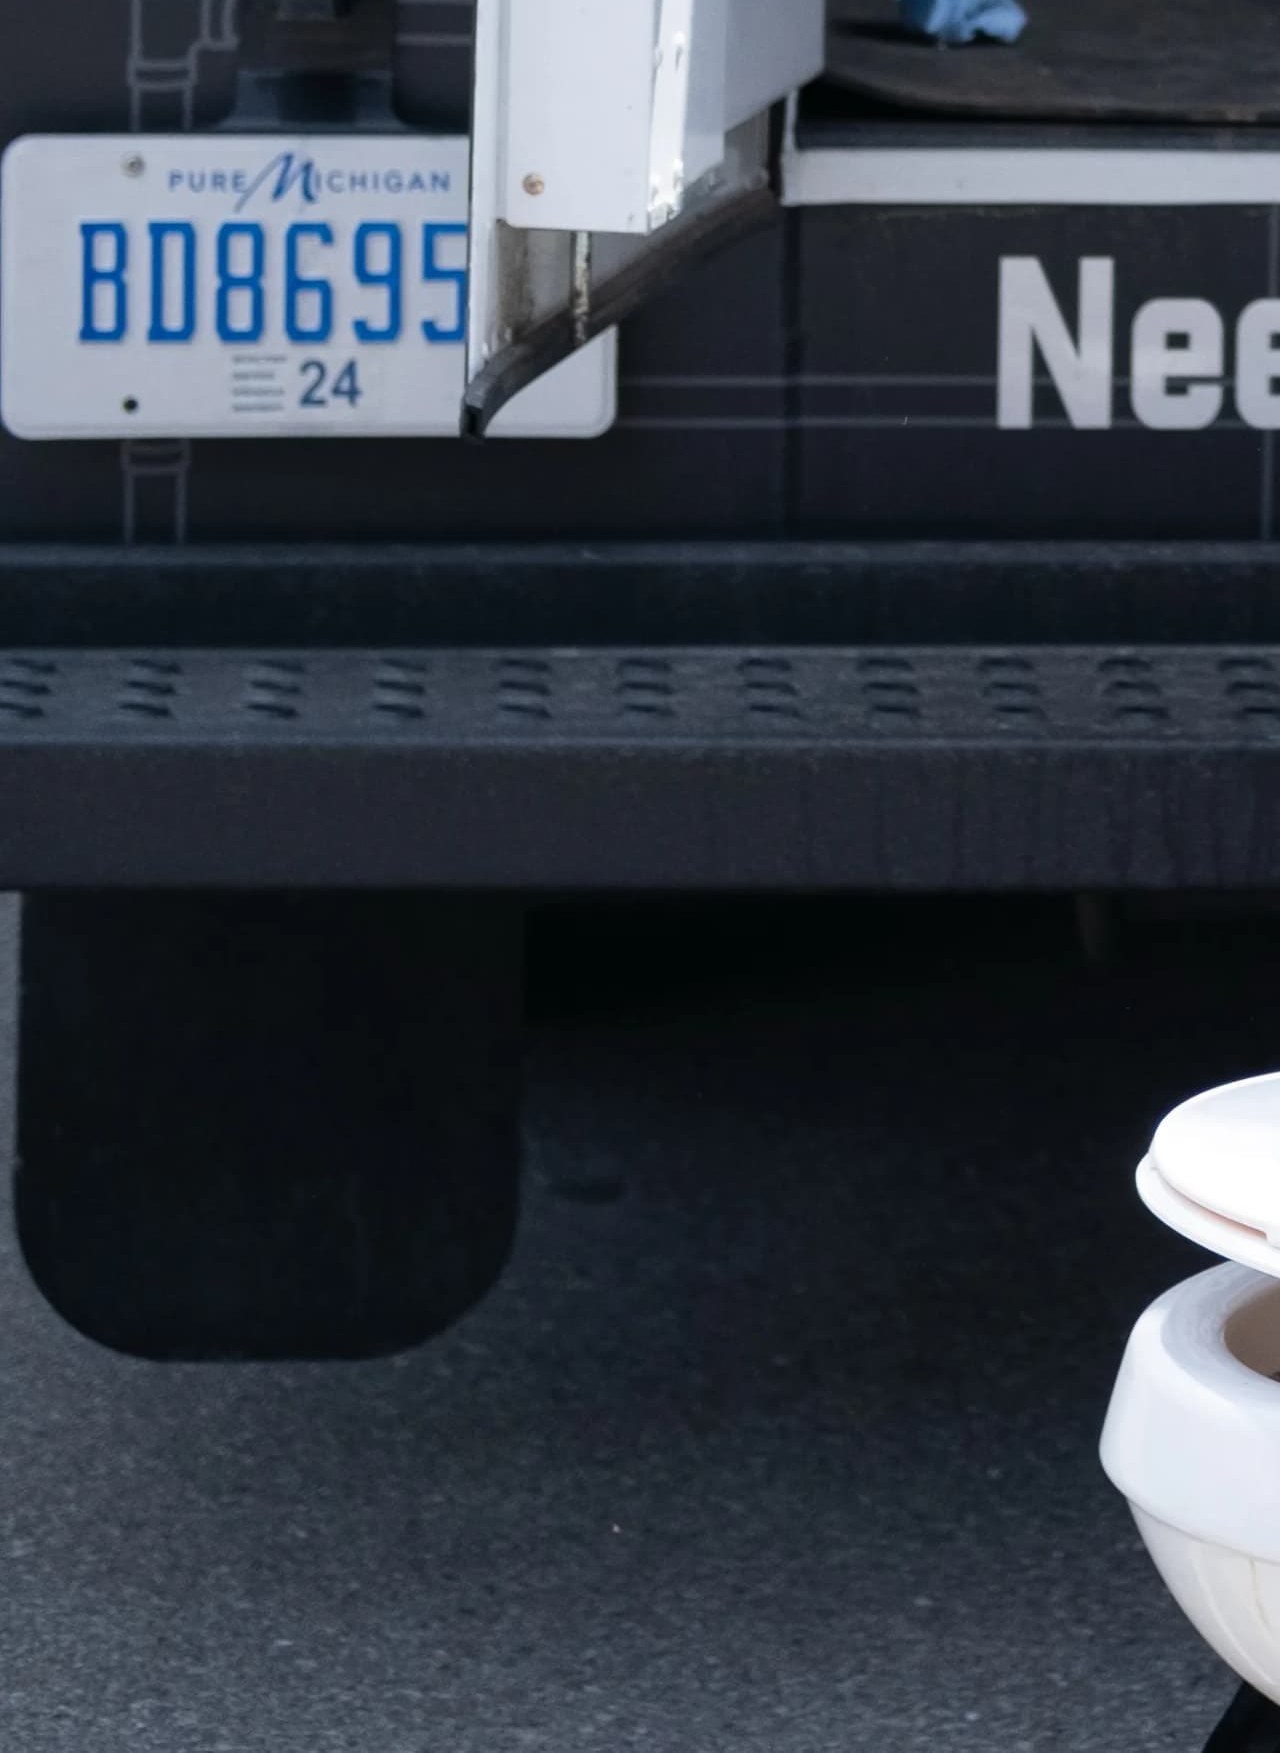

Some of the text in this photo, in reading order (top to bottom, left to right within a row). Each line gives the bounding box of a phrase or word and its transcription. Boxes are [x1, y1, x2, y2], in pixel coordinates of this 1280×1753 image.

[168, 151, 451, 213] PURE MICHIGAN
[299, 358, 362, 407] 24
